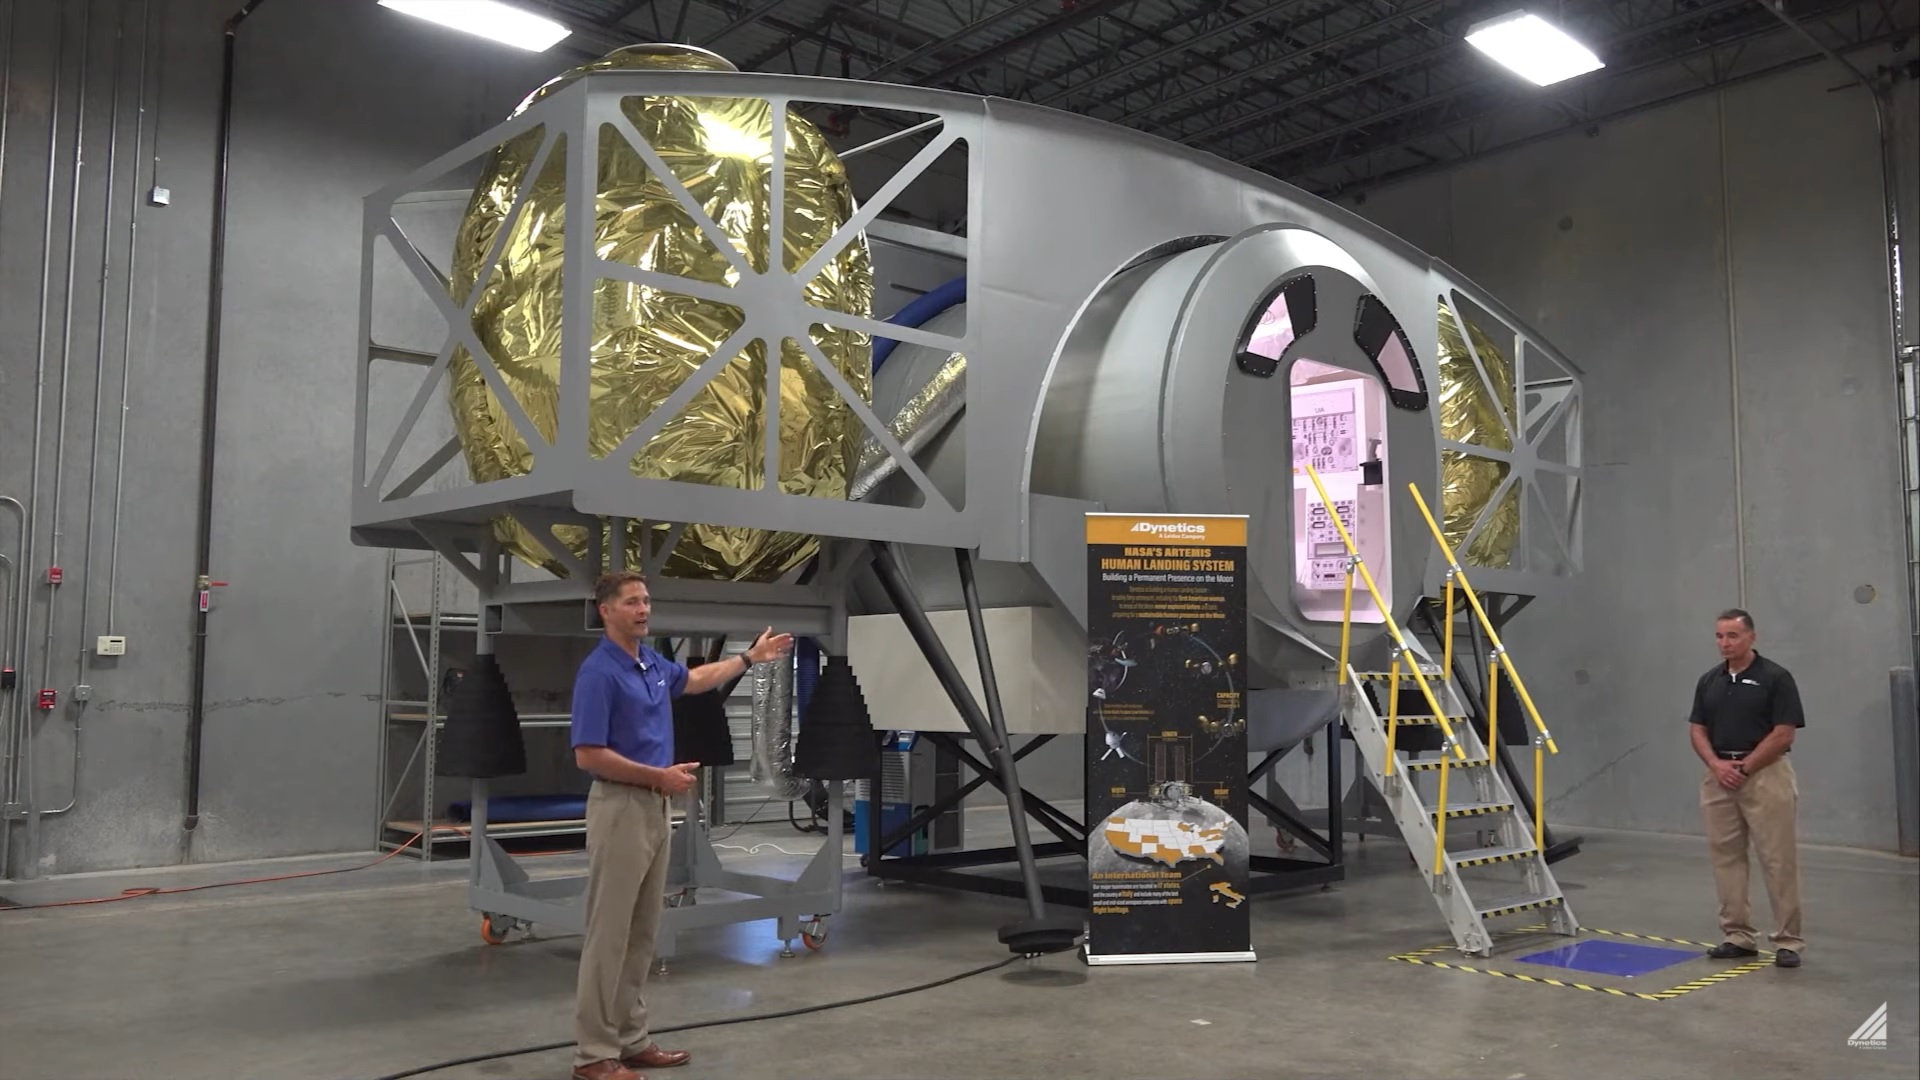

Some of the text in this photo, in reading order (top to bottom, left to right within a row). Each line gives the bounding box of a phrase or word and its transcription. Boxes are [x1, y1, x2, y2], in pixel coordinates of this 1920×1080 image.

[1139, 522, 1205, 534] Dynetics
[1124, 547, 1212, 558] NASA'S ARTEMIS
[1101, 558, 1235, 571] HUMAN LANDING SYSTEM
[1102, 573, 1127, 583] Building
[1133, 573, 1166, 582] Permanent
[1167, 574, 1195, 582] Presence
[1216, 575, 1234, 583] Moon
